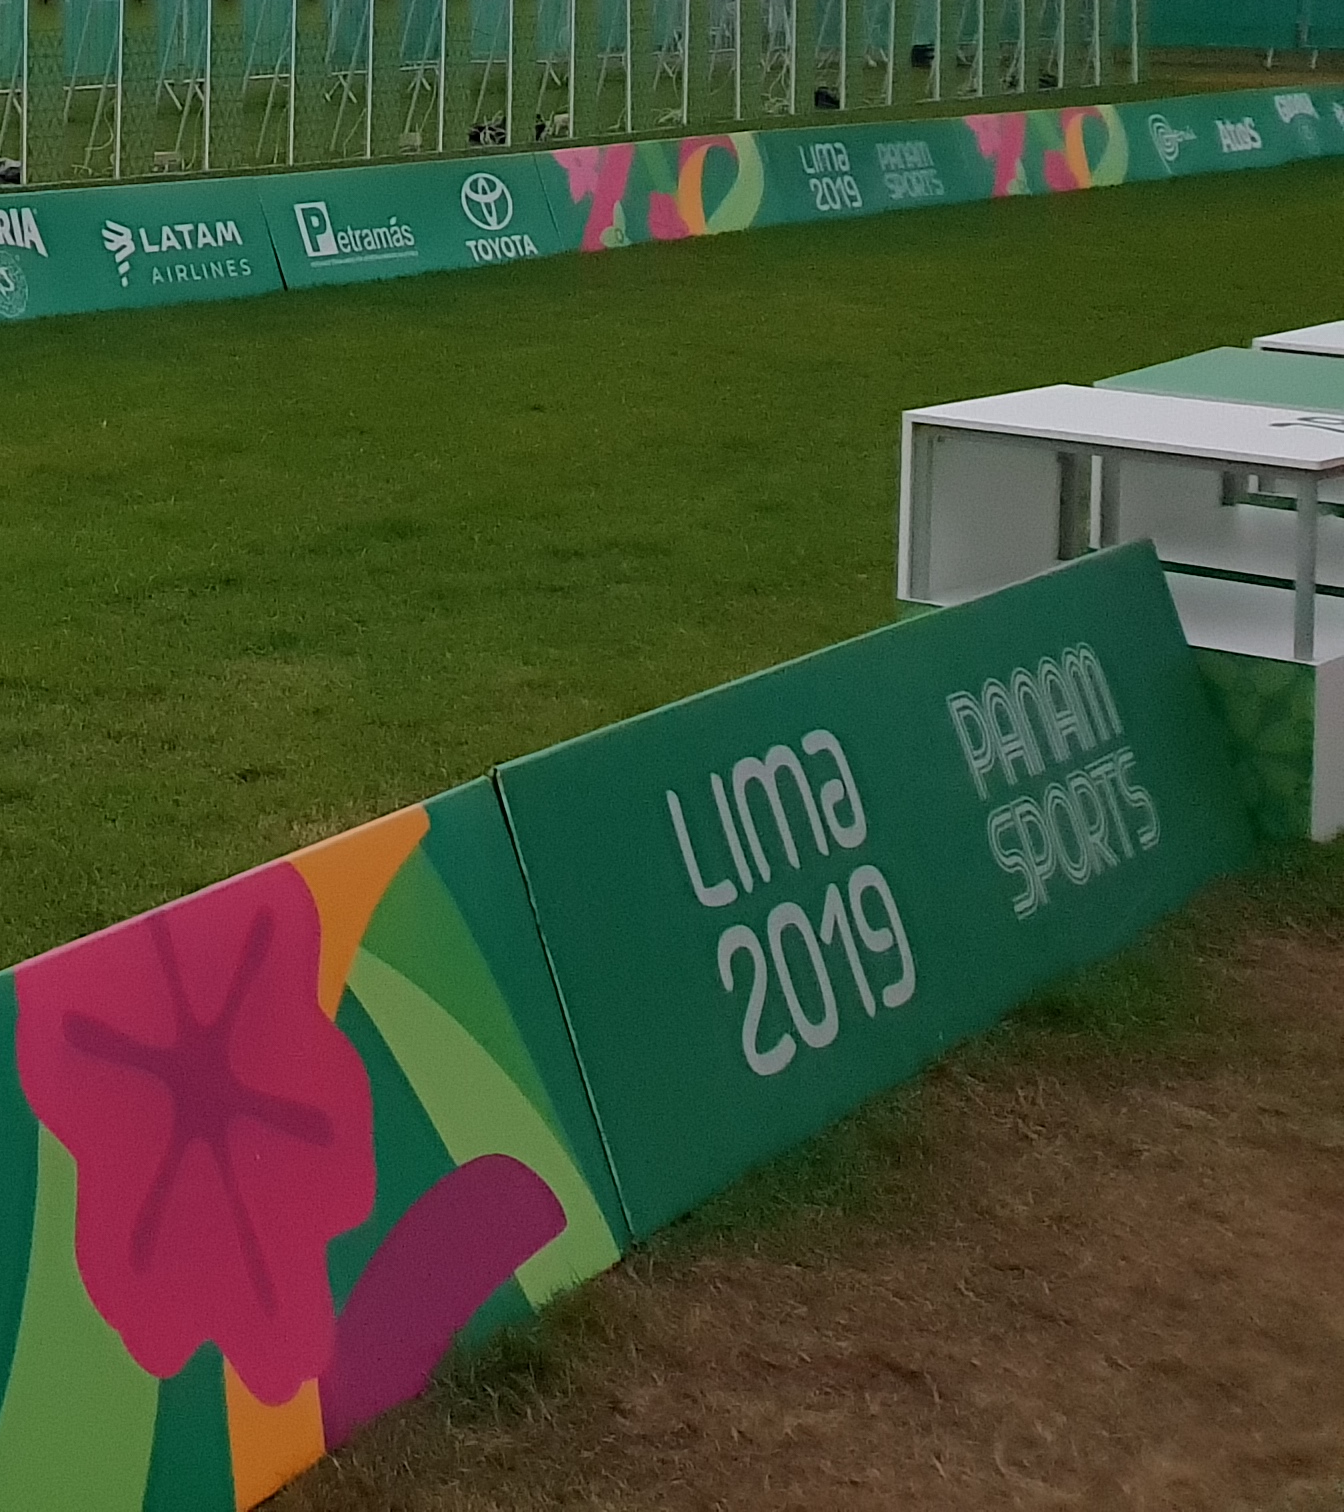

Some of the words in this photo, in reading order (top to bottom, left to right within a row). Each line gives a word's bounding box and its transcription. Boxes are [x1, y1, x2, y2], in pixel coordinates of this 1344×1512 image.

[809, 174, 863, 212] 2019
[138, 220, 244, 254] LATAM
[294, 200, 416, 258] Petramás
[465, 234, 539, 264] TOYOTA
[151, 257, 252, 286] AIRLINES
[945, 641, 1124, 802] PANAM
[986, 746, 1162, 922] SPORTS
[716, 863, 917, 1077] 2019
